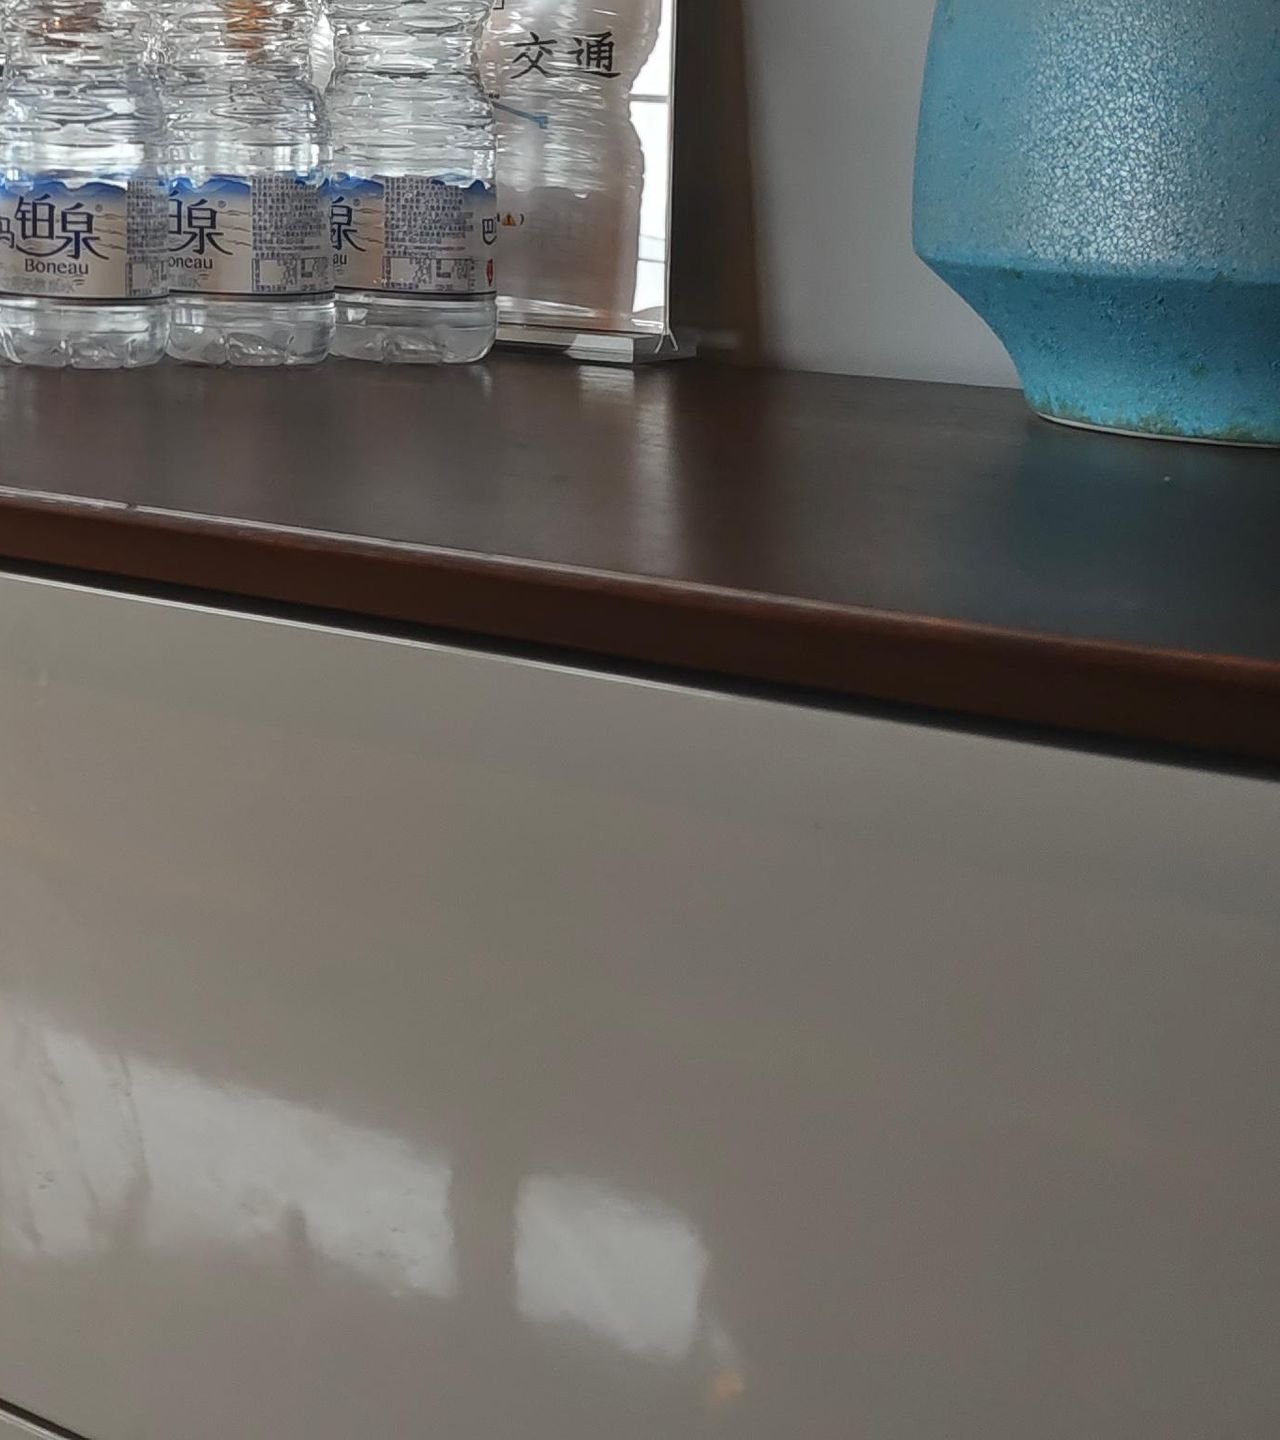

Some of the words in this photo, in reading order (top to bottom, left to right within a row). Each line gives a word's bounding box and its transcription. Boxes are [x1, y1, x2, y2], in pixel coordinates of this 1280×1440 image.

[510, 31, 621, 79] 交通
[25, 259, 88, 275] Boneau
[169, 255, 213, 270] oneau
